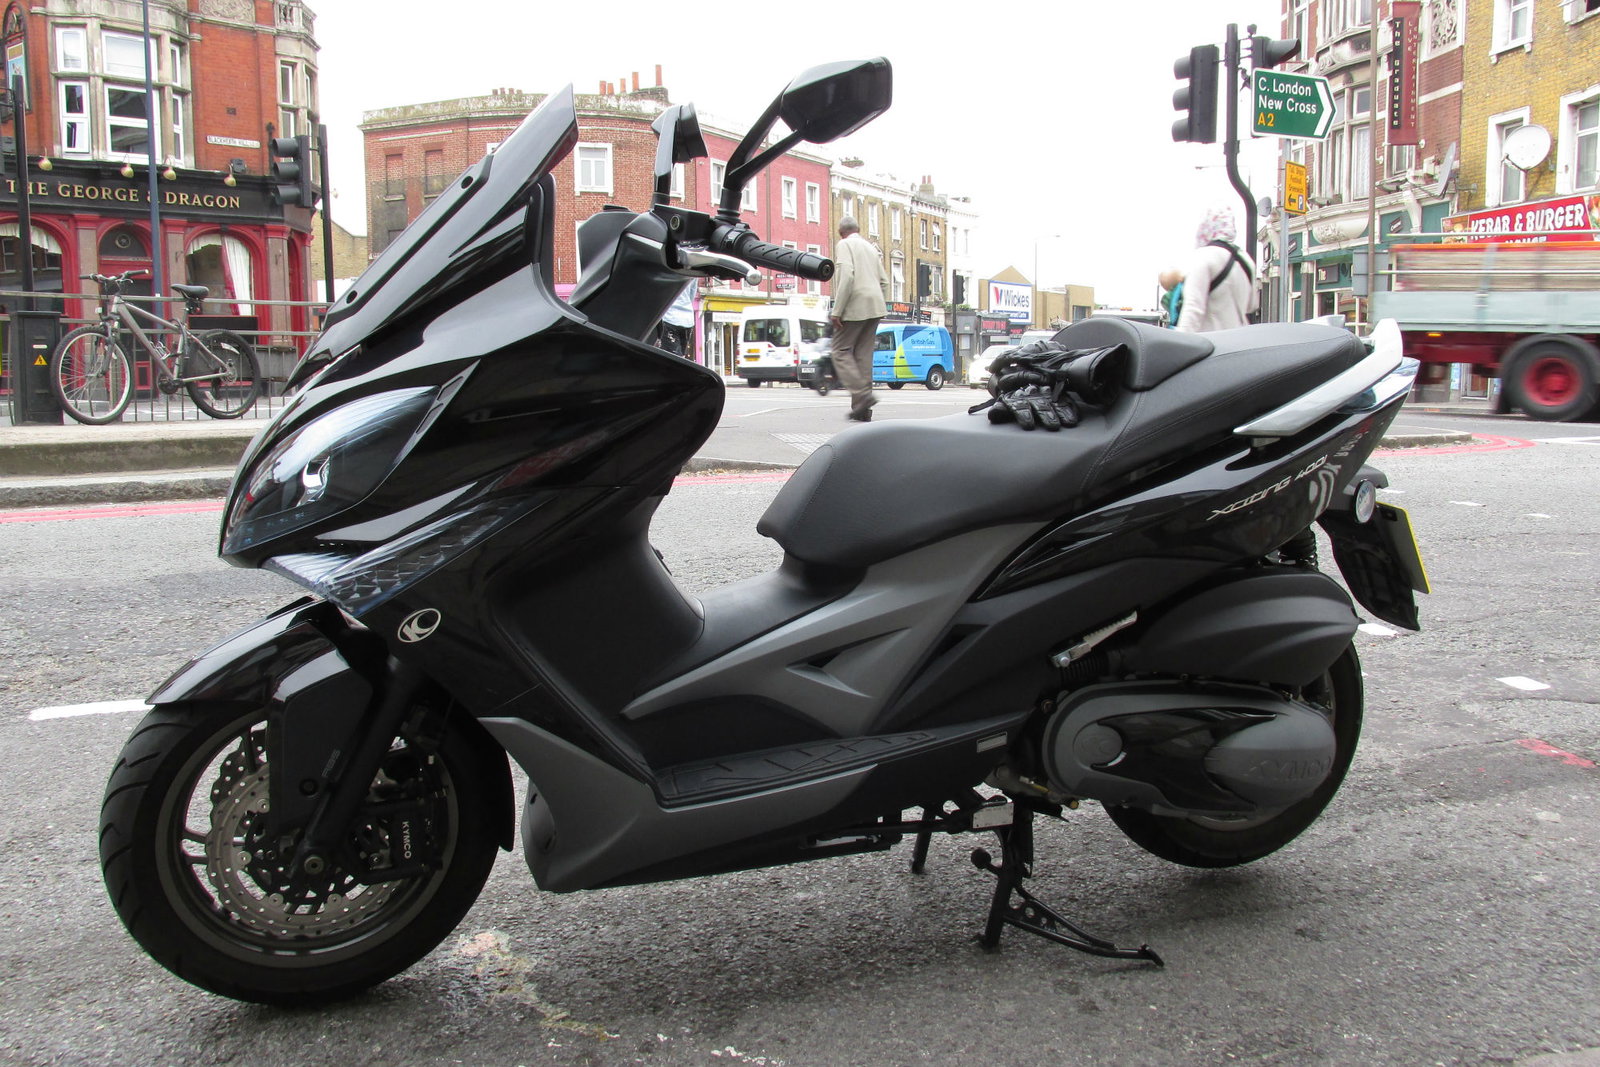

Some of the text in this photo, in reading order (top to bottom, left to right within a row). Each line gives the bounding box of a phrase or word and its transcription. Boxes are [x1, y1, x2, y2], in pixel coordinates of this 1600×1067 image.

[1258, 76, 1312, 97] C. London
[1258, 94, 1317, 115] New Cross
[1257, 111, 1275, 127] A2
[57, 182, 139, 202] GEORGE
[164, 191, 240, 209] DRAGON
[1470, 203, 1586, 240] KEBAB & BURGER
[1004, 288, 1030, 308] Wickes
[402, 821, 412, 860] KYMCO
